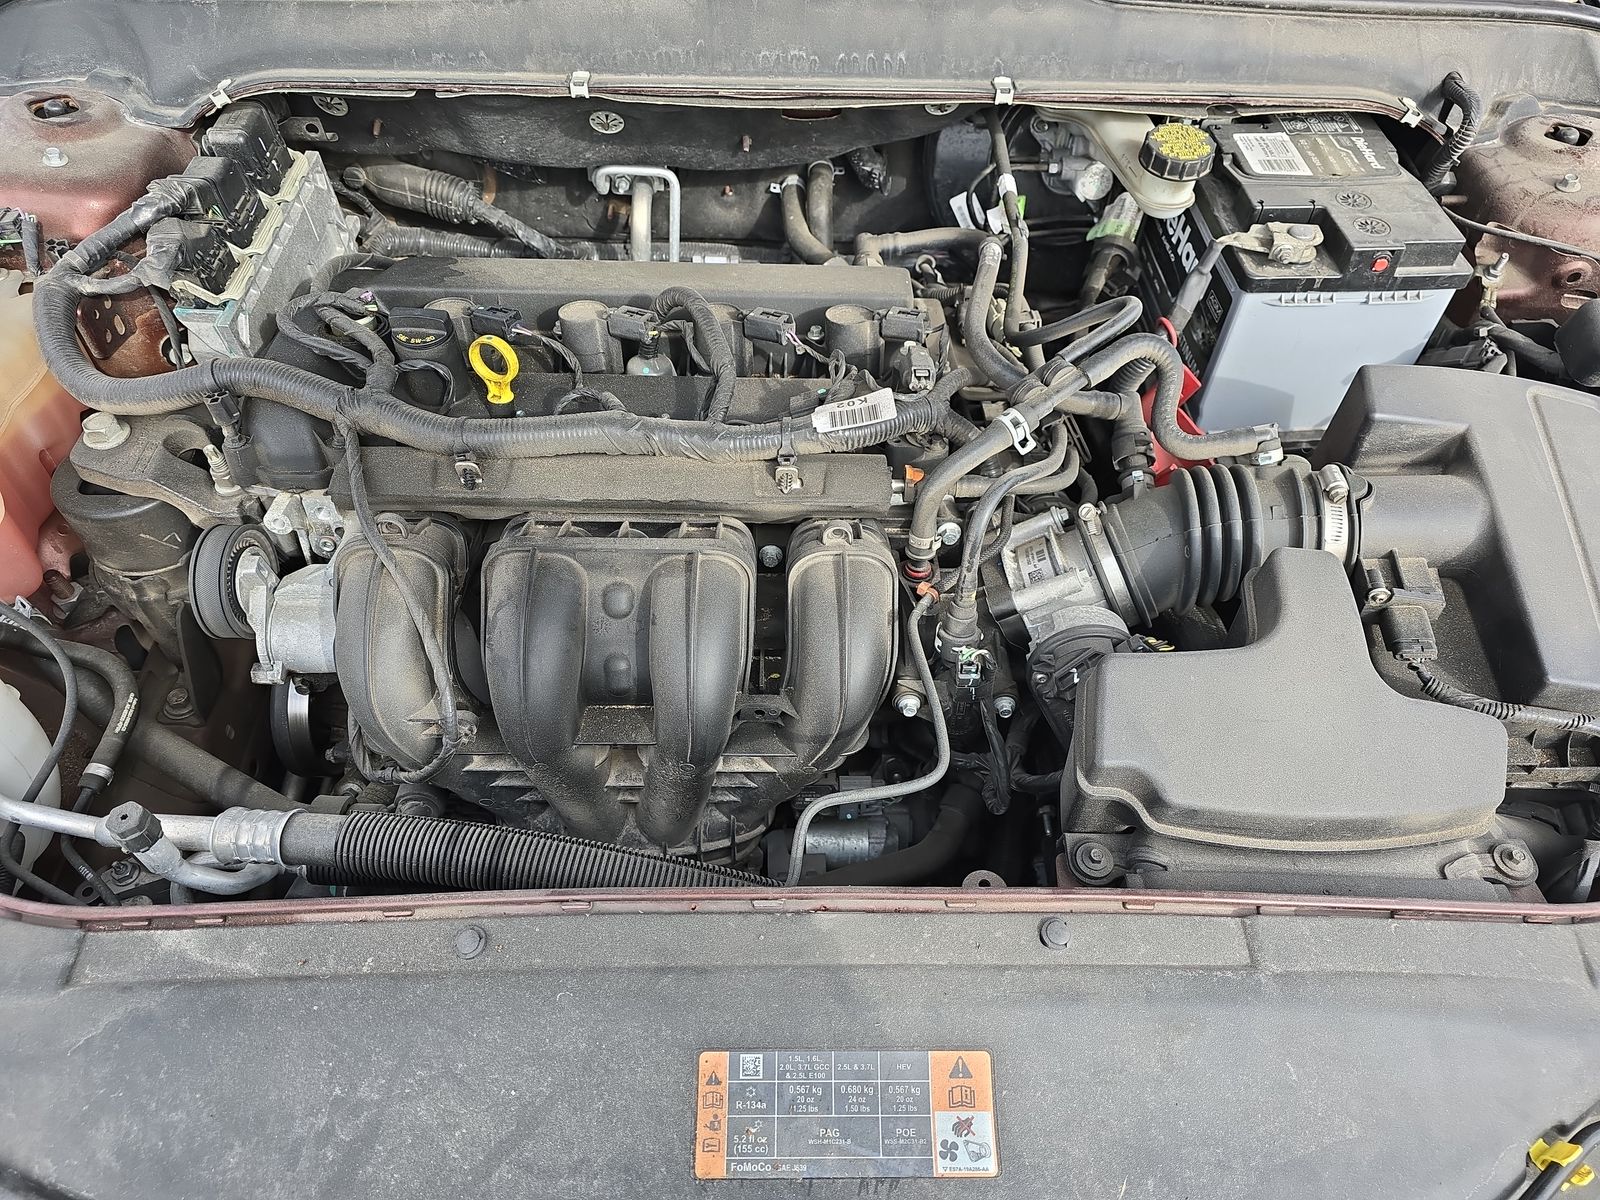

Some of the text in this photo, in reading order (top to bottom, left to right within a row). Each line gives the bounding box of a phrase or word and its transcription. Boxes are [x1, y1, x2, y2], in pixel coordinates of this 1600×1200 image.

[1350, 136, 1386, 169] DieHard
[789, 1055, 804, 1063] 1.5L,
[780, 1063, 830, 1071] 2.0L, 3.7L GCC
[788, 1085, 822, 1096] 0.567 kg
[840, 1085, 874, 1095] 0.680 kg
[888, 1085, 921, 1095] 0.567 kg
[735, 1100, 767, 1109] R-134a
[819, 1128, 840, 1137] PAG
[896, 1128, 916, 1137] POE
[733, 1135, 746, 1143] 5.2
[748, 1135, 755, 1143] fl
[733, 1144, 769, 1154] (155 cc)
[730, 1162, 772, 1172] FoMoCo
